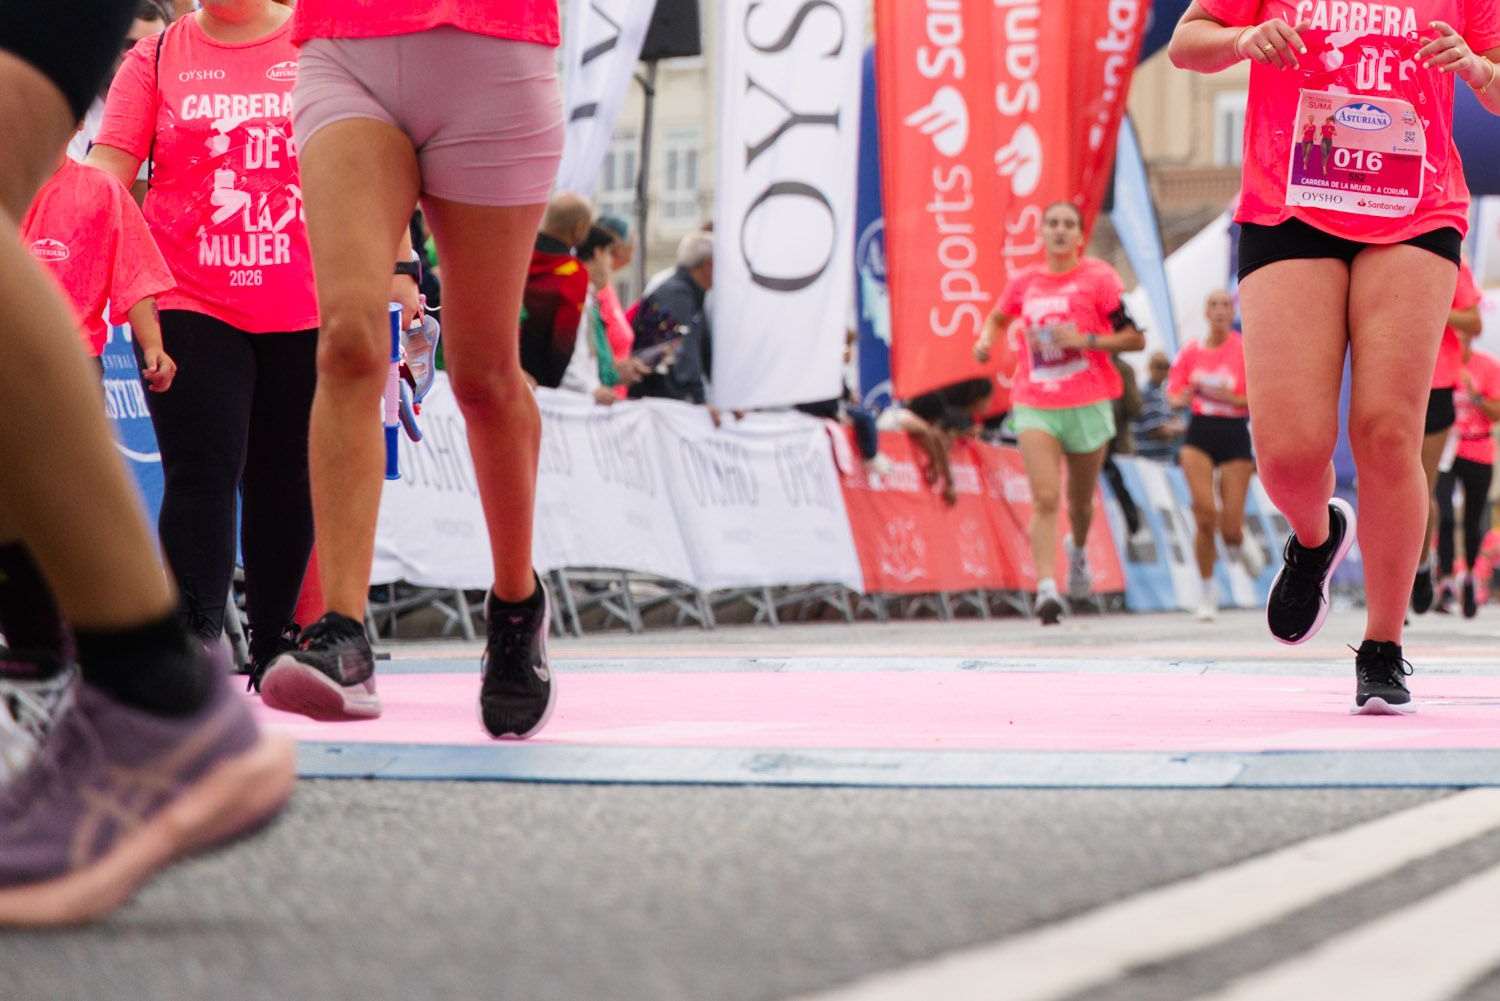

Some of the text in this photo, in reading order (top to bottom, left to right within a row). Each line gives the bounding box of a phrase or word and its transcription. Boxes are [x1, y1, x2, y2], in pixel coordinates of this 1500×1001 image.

[179, 69, 226, 83] OYSHO
[1356, 46, 1392, 91] DE
[1339, 110, 1388, 127] ASTURIANA
[244, 127, 283, 170] DE
[1333, 148, 1383, 171] 016
[1301, 177, 1329, 187] CARRERA
[1350, 183, 1371, 192] MUJER
[1383, 187, 1409, 196] CORUÑA
[1348, 173, 1365, 182] 552
[1302, 191, 1406, 212] OYSHO Santander
[243, 195, 274, 233] LA
[199, 232, 291, 267] MUJER
[926, 164, 991, 338] Sports
[229, 269, 263, 287] 2026
